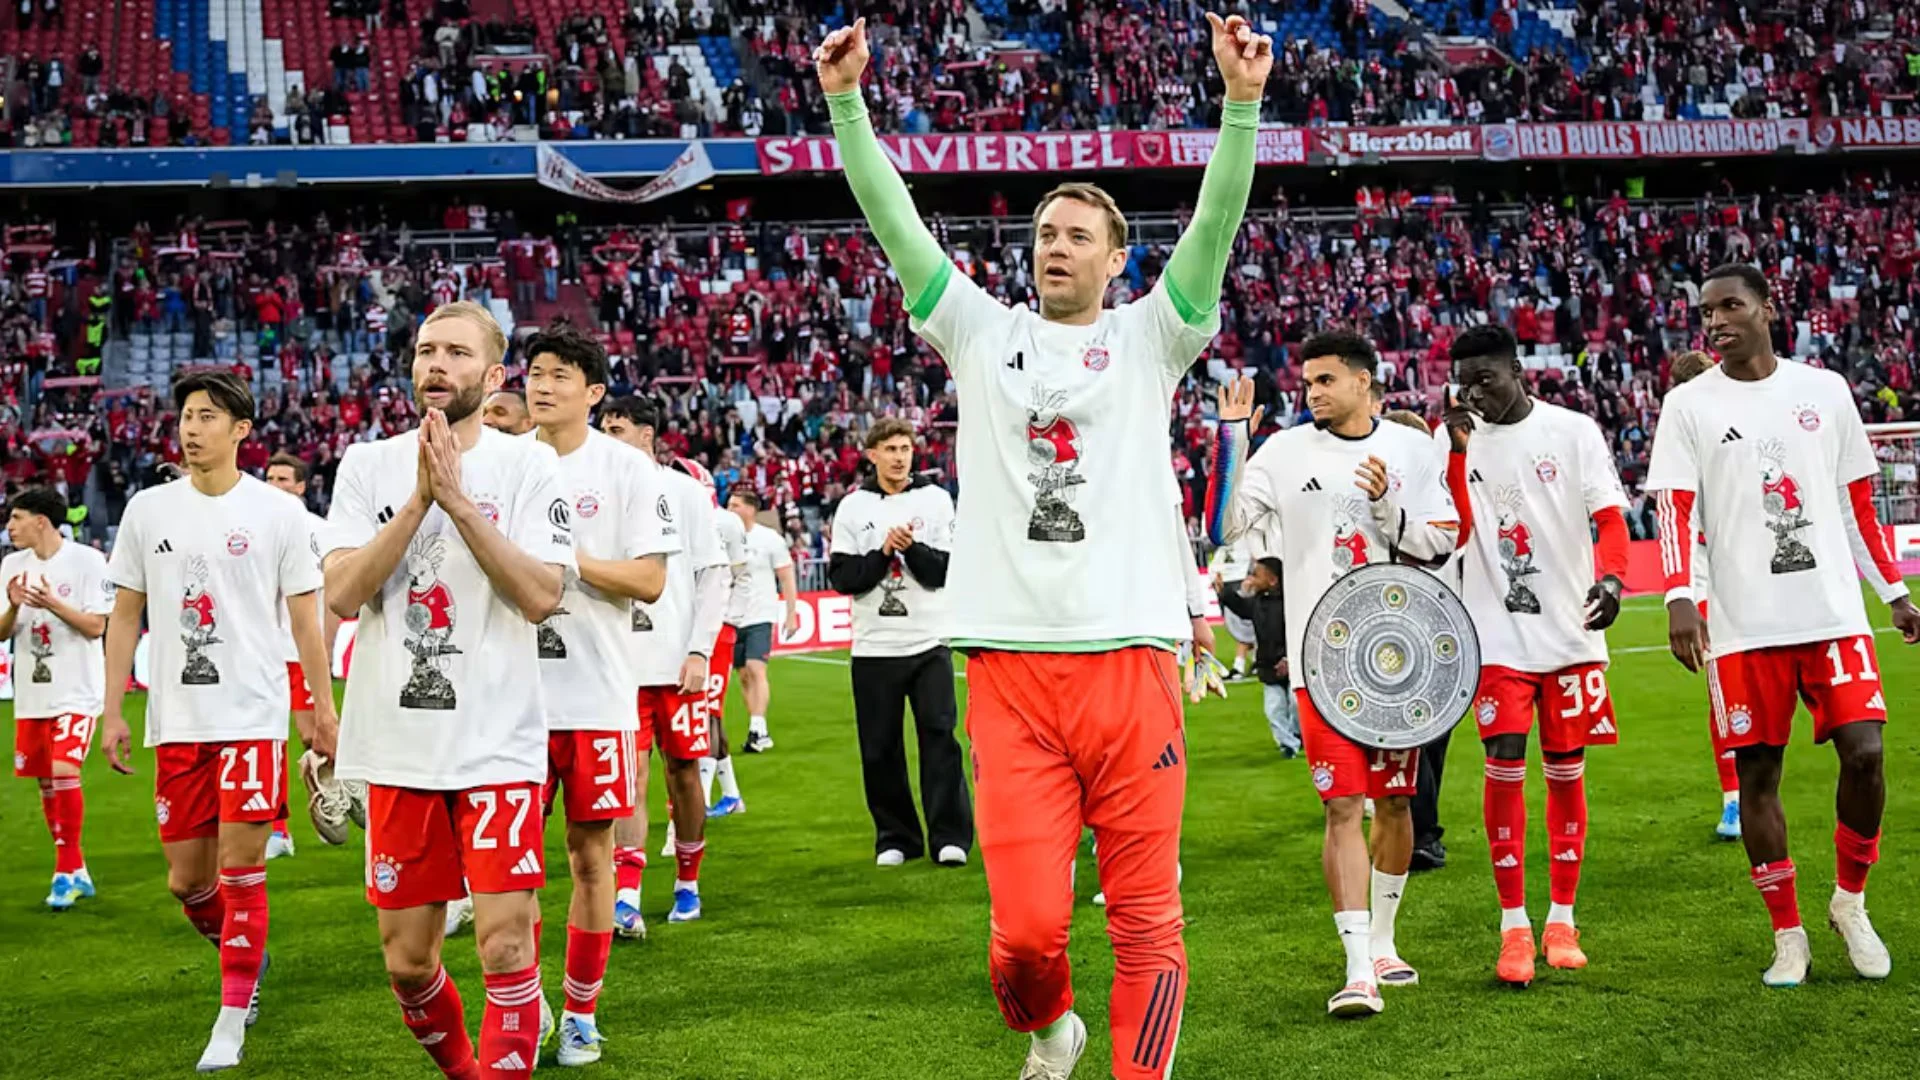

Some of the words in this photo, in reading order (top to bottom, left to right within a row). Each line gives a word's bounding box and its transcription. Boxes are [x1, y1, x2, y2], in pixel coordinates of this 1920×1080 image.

[764, 134, 1126, 173] S'INVIERTEL
[1348, 130, 1473, 152] Herzbladl
[1520, 123, 1564, 156] RED
[1566, 123, 1634, 156] BULLS
[1636, 121, 1779, 154] TAUBENBACH
[1825, 637, 1878, 686] 11
[1558, 669, 1607, 718] 39
[53, 714, 91, 744] 34
[671, 700, 710, 737] 45
[220, 746, 263, 790] 21
[593, 737, 620, 785] 3
[468, 788, 531, 850] 27
